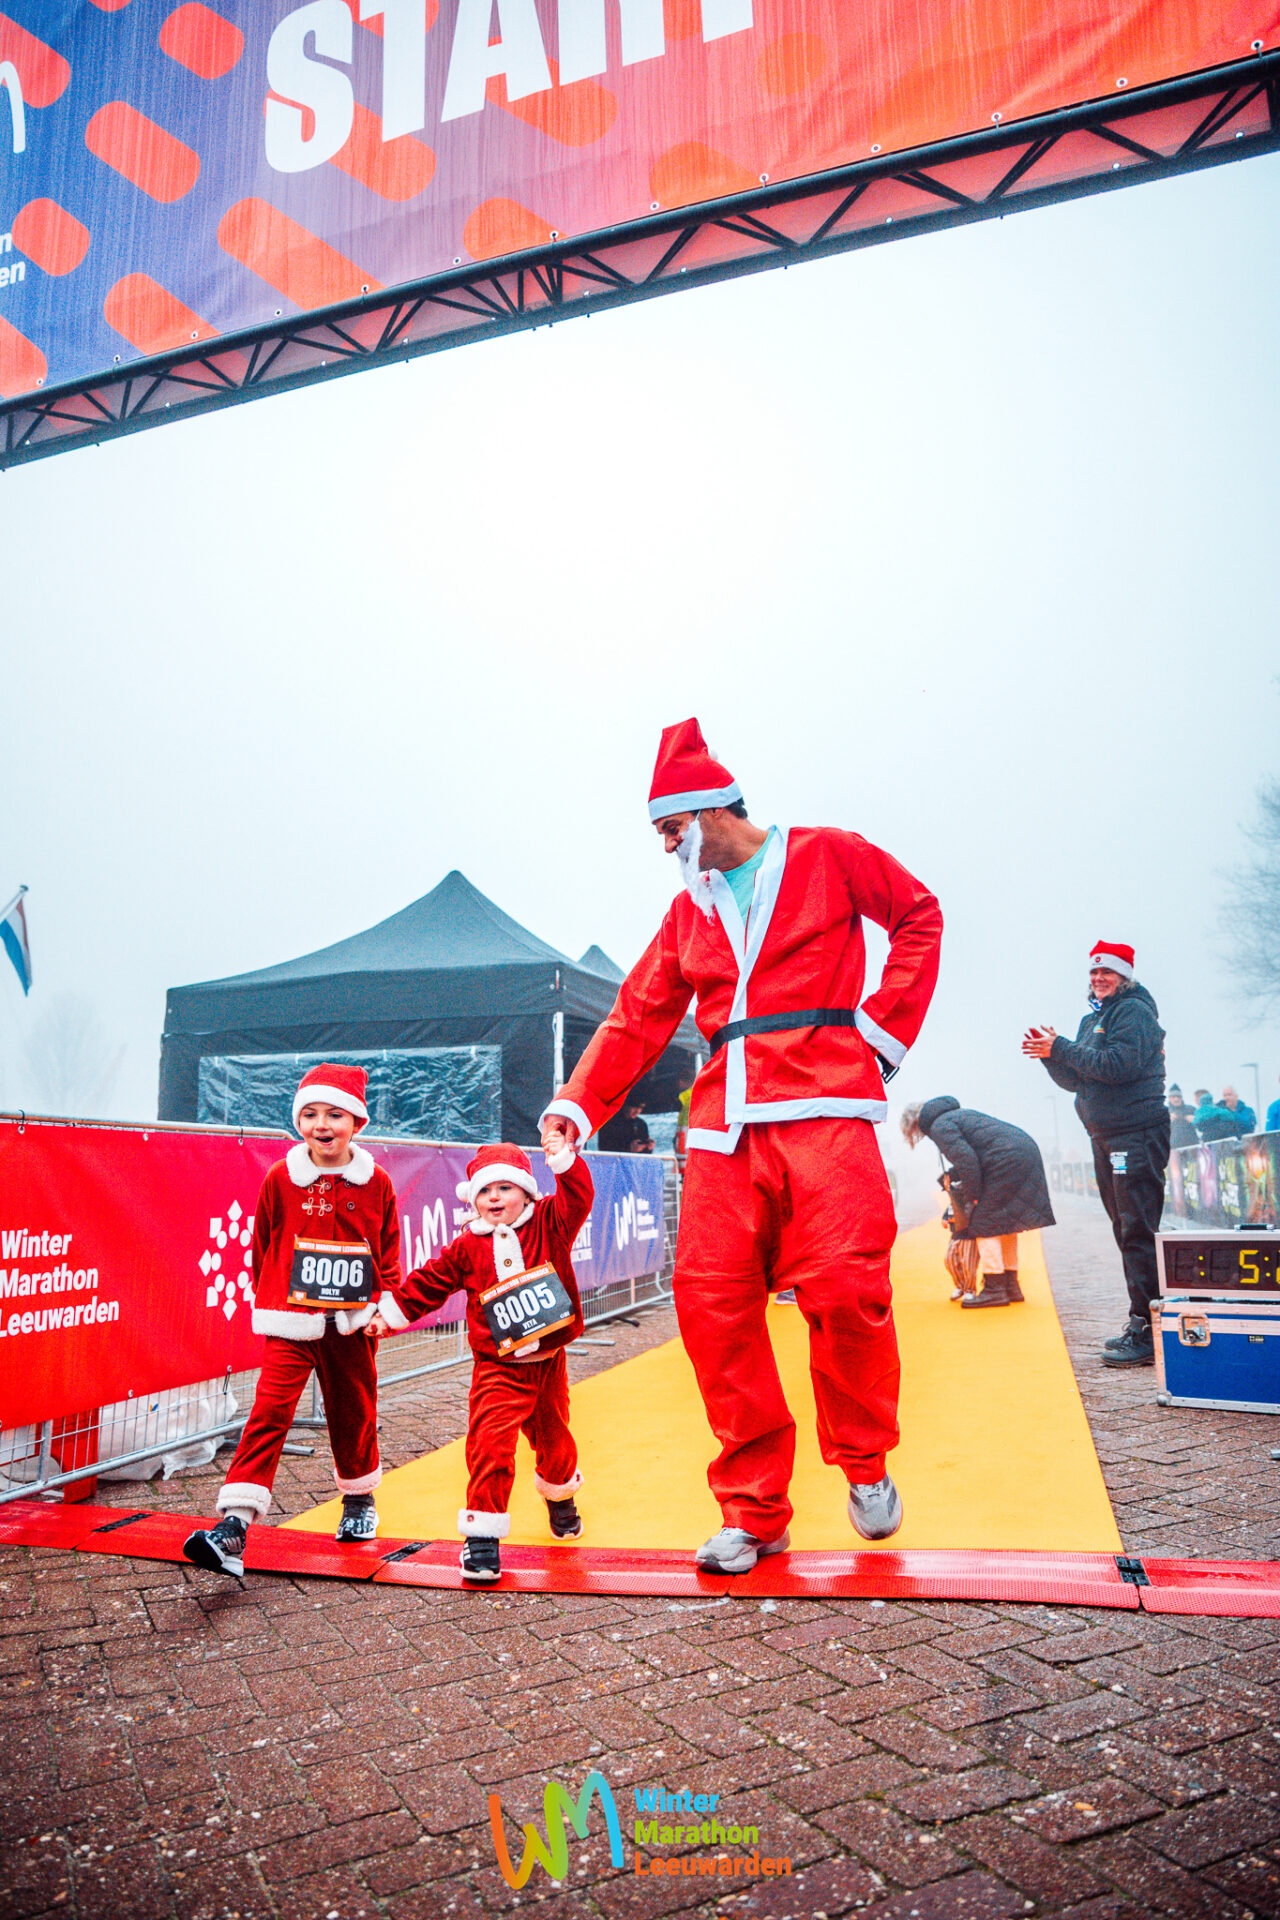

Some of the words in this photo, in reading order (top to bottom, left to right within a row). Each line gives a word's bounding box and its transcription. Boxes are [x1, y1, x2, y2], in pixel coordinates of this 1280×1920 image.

[265, 0, 754, 173] STA
[1, 1228, 73, 1260] Winter
[0, 1262, 98, 1299] Marathon
[301, 1256, 364, 1288] 8006
[0, 1296, 120, 1338] Leeuwarden
[493, 1282, 557, 1330] 8005
